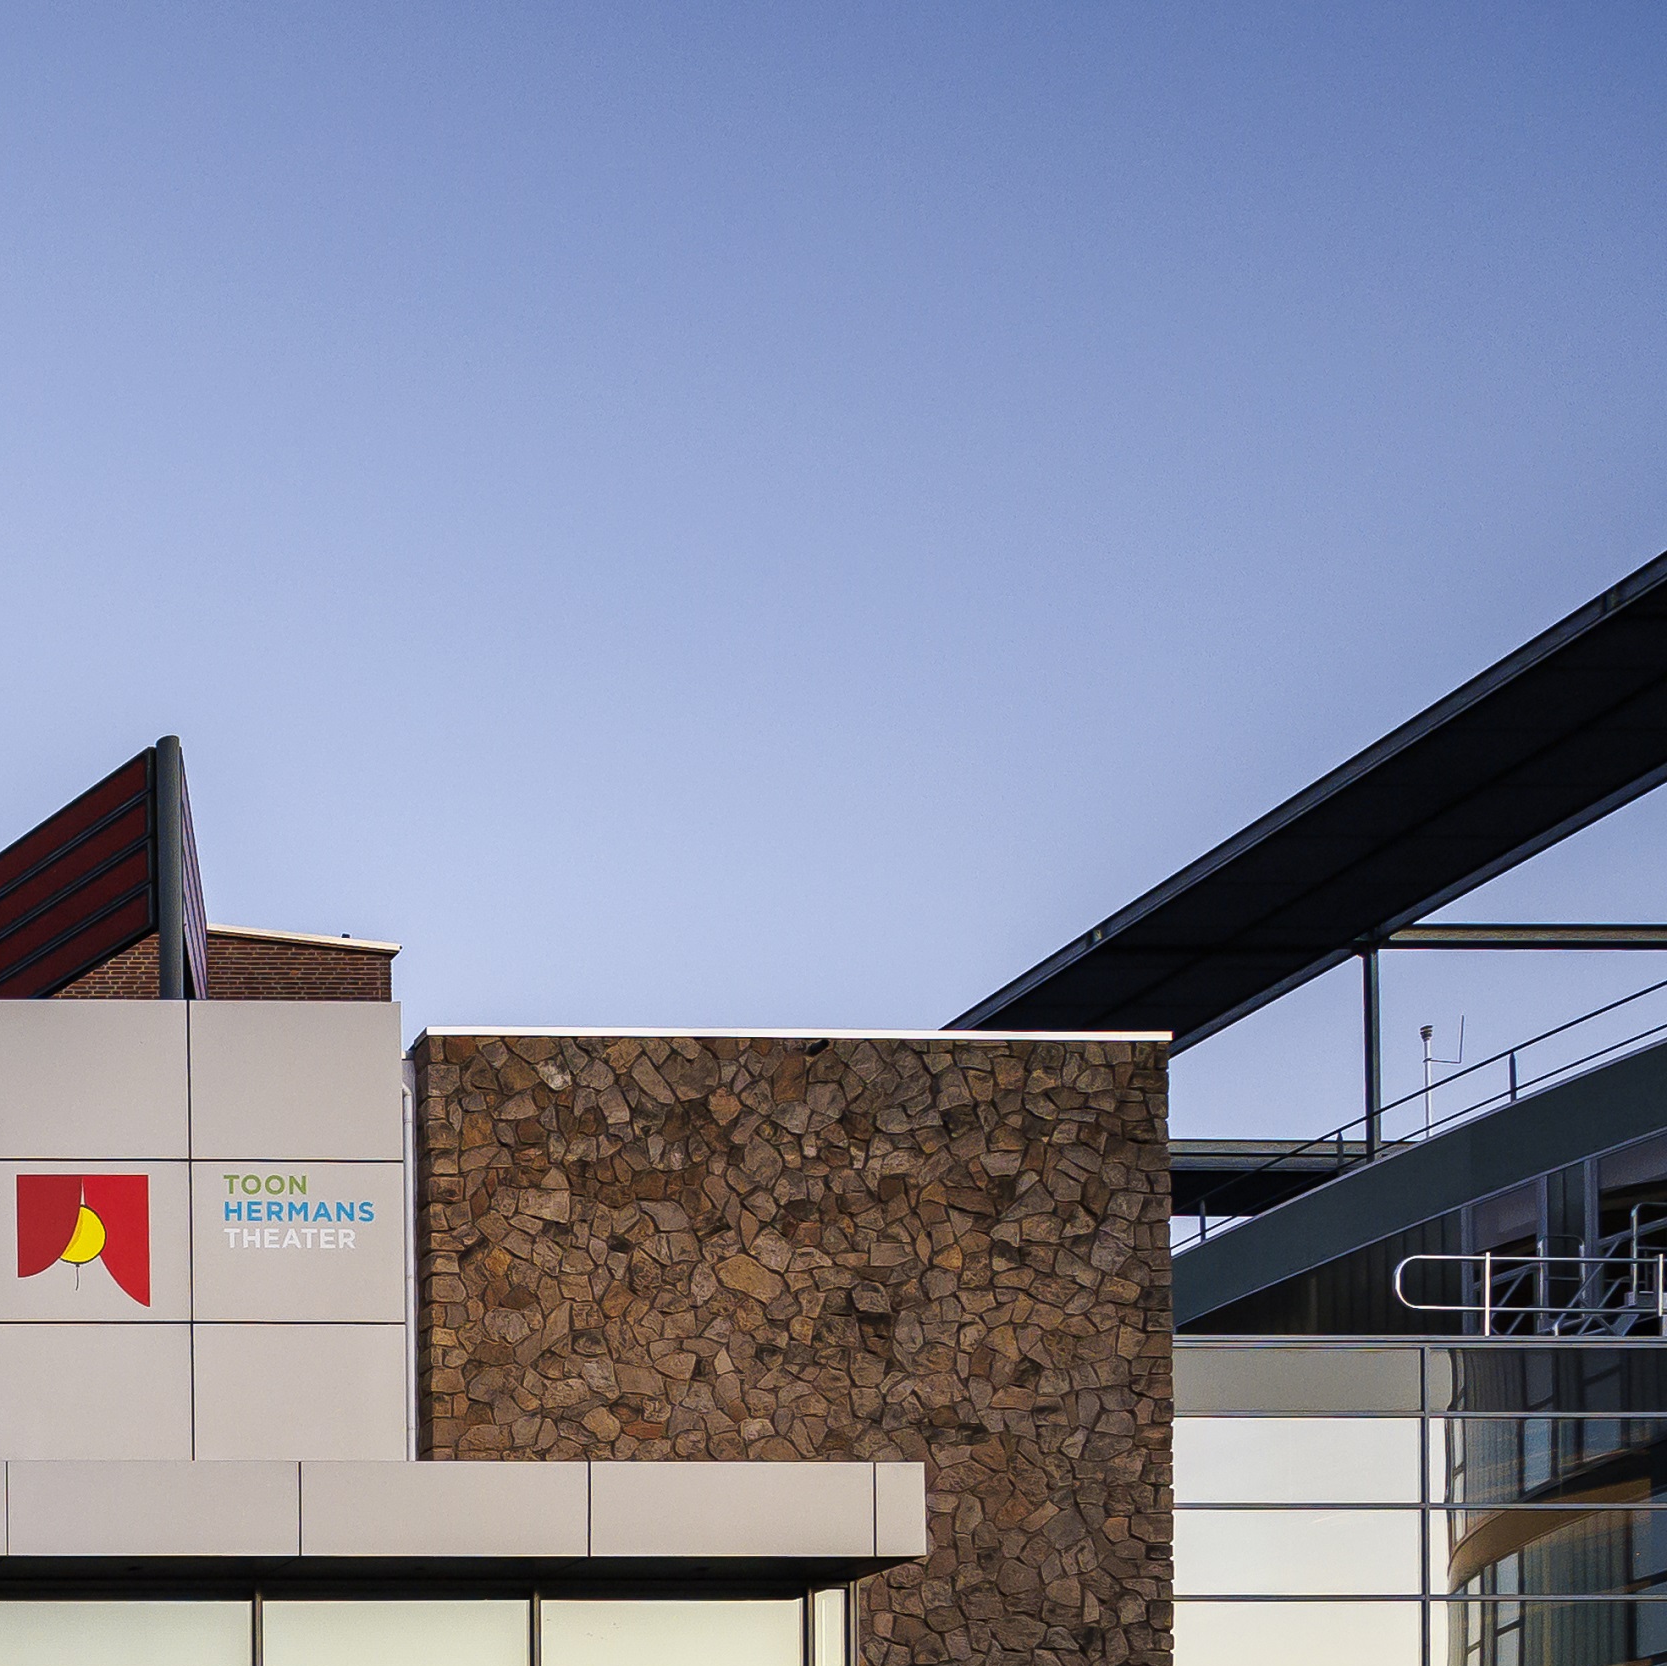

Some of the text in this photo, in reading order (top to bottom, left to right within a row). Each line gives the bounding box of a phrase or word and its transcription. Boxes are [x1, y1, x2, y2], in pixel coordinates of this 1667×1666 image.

[223, 1174, 308, 1196] TOON
[223, 1201, 375, 1222] HERMANS
[223, 1228, 357, 1250] THEATER
